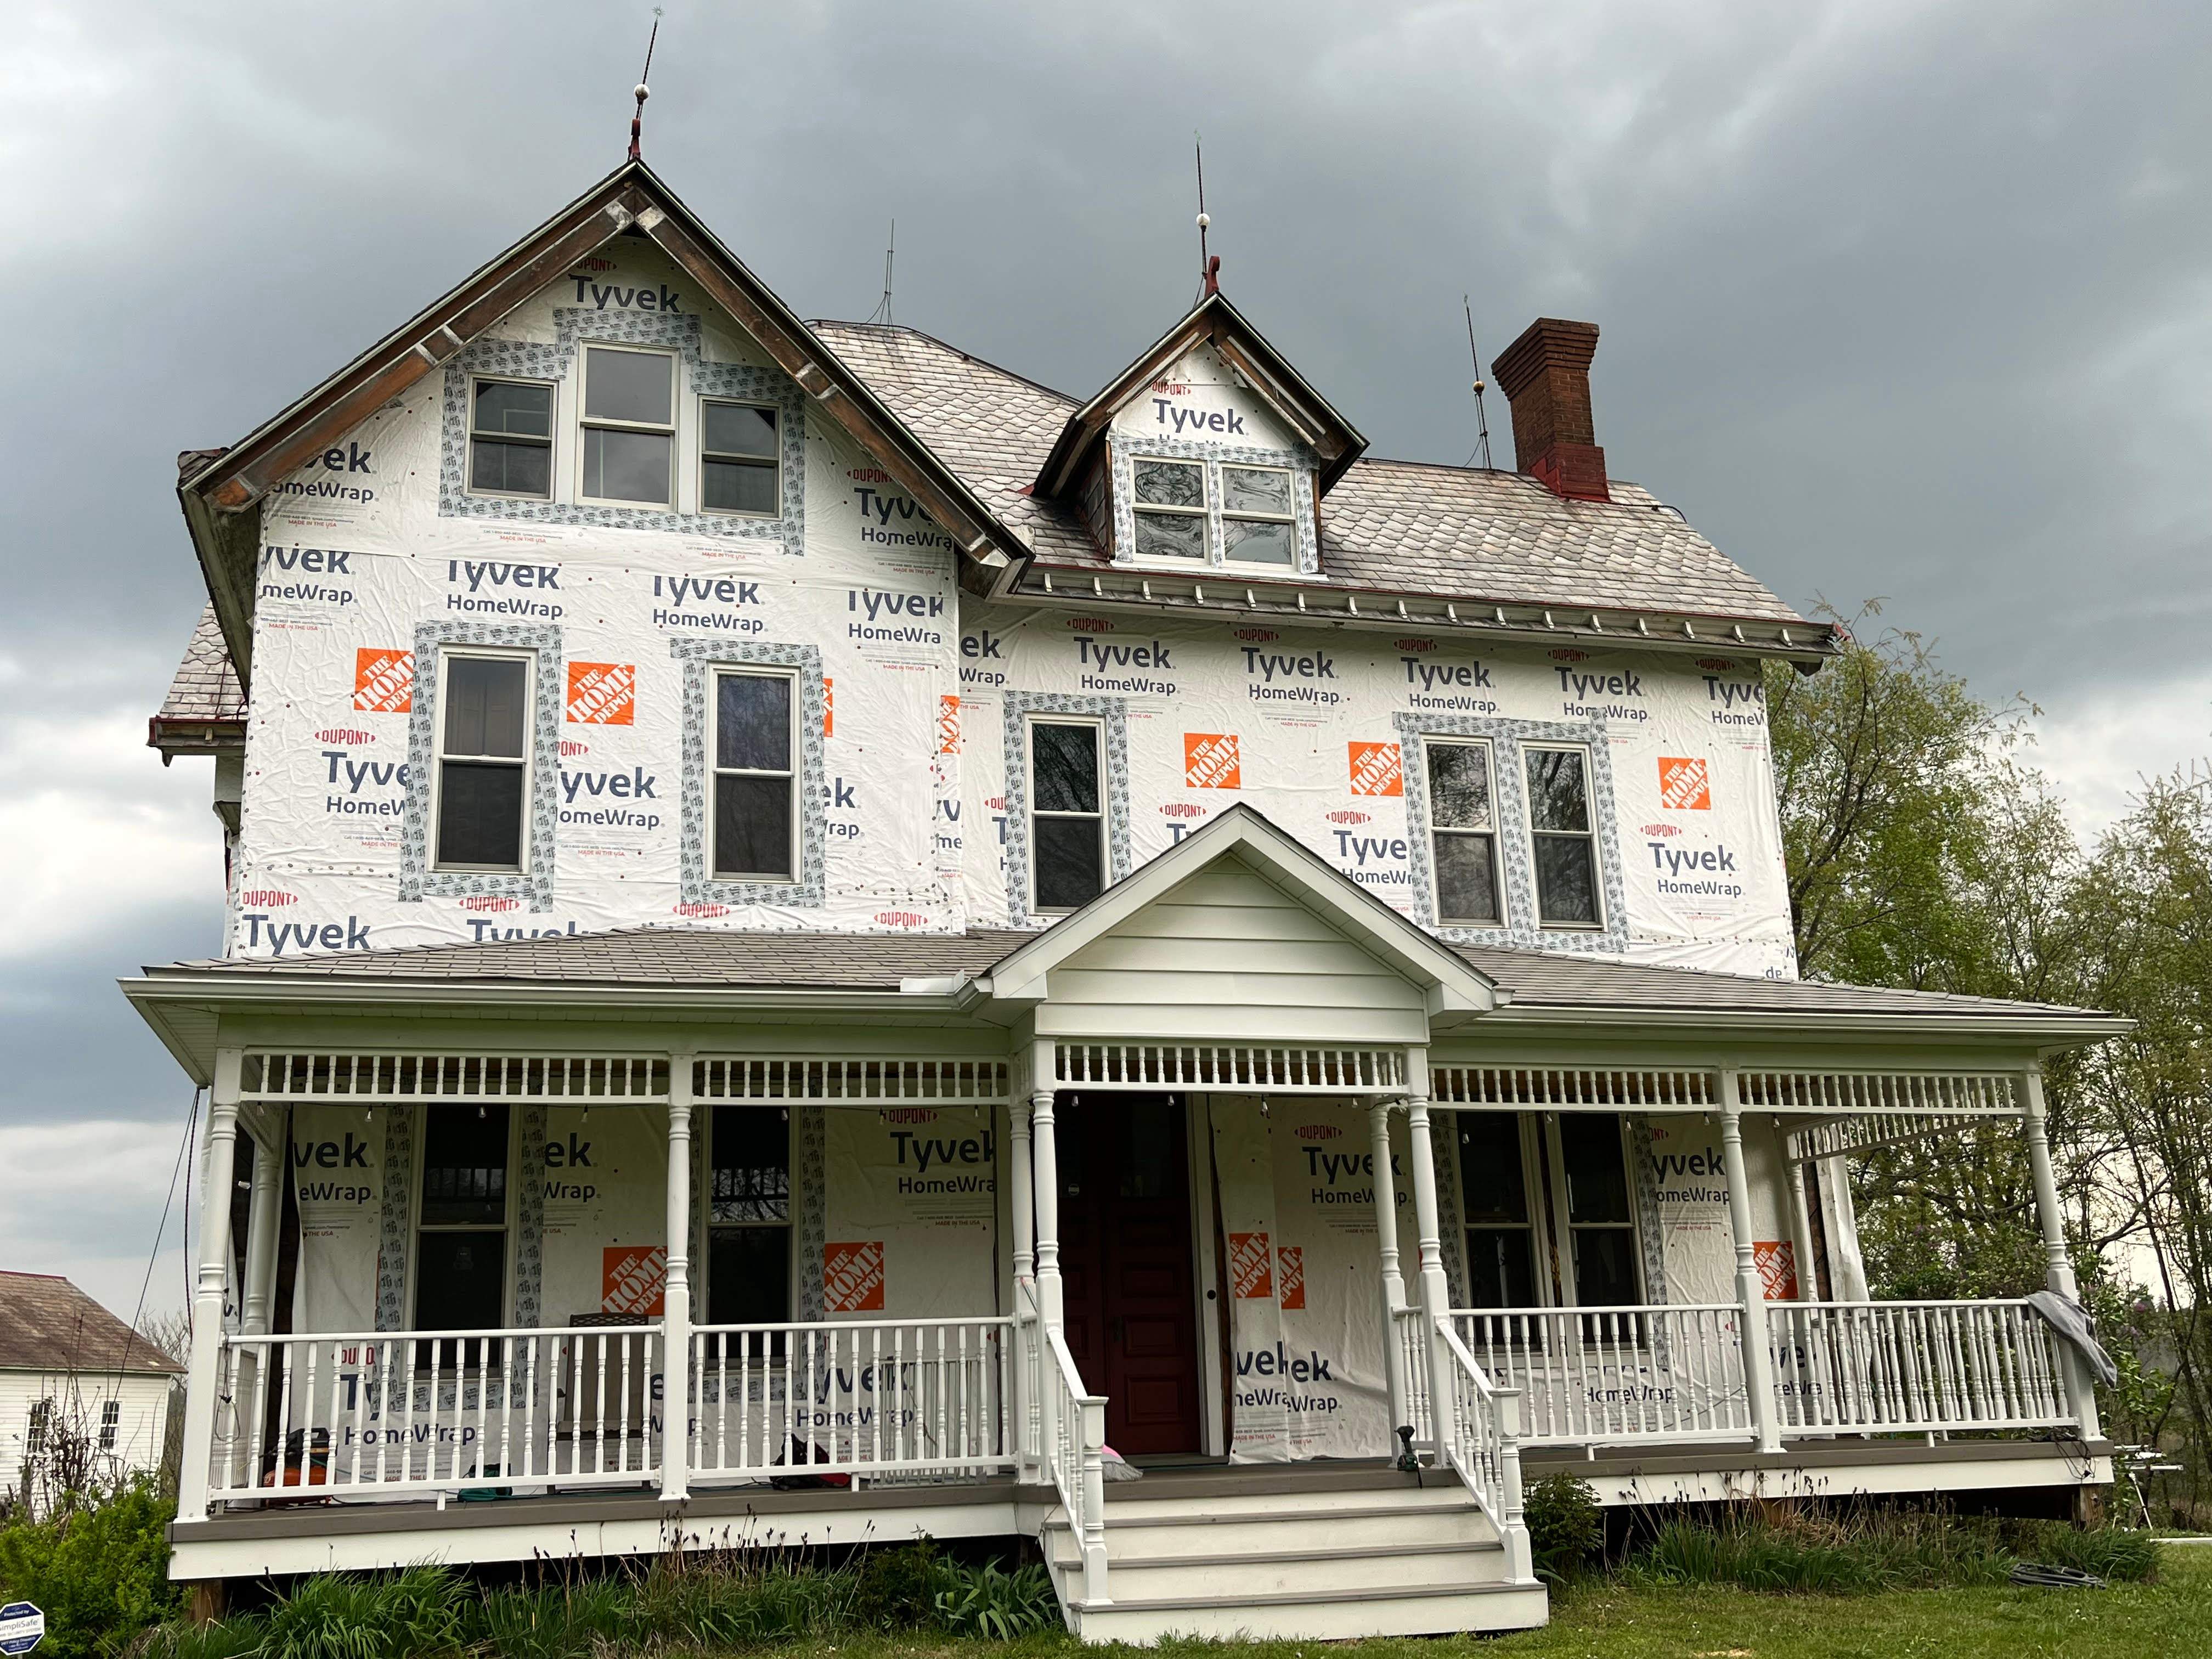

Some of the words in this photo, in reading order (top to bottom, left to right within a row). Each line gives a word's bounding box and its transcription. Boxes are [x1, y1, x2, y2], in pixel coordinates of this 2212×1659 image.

[578, 257, 612, 272] UPONT
[568, 274, 680, 313] Tyvek
[1152, 381, 1187, 395] DUPONT
[1153, 398, 1244, 435] Tyvek
[272, 481, 374, 504] omeWrap
[854, 488, 934, 525] Tyv
[862, 527, 952, 548] HomeWra
[261, 546, 350, 575] vek
[262, 584, 353, 605] meWrap
[447, 594, 563, 620] HomeWrap
[653, 609, 763, 634] HomeWrap
[849, 623, 940, 644] HomeWra
[1073, 618, 1109, 632] DUPONT
[1239, 629, 1274, 642] DUPONT
[1399, 639, 1434, 652] DUPONT
[1074, 636, 1171, 672] Tyvek
[1241, 647, 1335, 682] Tyvek
[1553, 649, 1585, 662] DUPONT
[1701, 658, 1730, 671] DUPONT
[363, 655, 393, 680] THE
[1401, 657, 1492, 691] Tyvek
[567, 664, 635, 723] HOME
[574, 669, 602, 693] THE
[1082, 674, 1176, 696] HomeWrap
[1555, 667, 1642, 700] Tyvek
[382, 683, 412, 712] DEP
[593, 688, 635, 725] DEPOT
[1249, 684, 1339, 706] HomeWrap
[1409, 693, 1496, 714] HomeWrap
[323, 729, 369, 745] DUPONT
[560, 741, 583, 756] ONT
[1190, 738, 1213, 761] THE
[1186, 733, 1239, 788] HOME
[1351, 743, 1401, 795] HOME
[1355, 747, 1374, 769] THE
[321, 751, 409, 793] Tyve
[557, 763, 656, 803] yvek
[1207, 754, 1239, 788] DEPOT
[1372, 763, 1402, 796] DEPOT
[1664, 763, 1683, 783] THE
[1662, 759, 1707, 809] HOME
[1680, 779, 1708, 810] DEPOT
[326, 797, 404, 815] Home
[1165, 804, 1201, 817] DUPONT
[1331, 812, 1366, 824] DUPONT
[1645, 824, 1677, 837] DUPONT
[1333, 830, 1407, 866] Tyve
[1647, 843, 1735, 877] Tyvek
[243, 891, 292, 907] DUPONT
[1658, 879, 1741, 898] HomeWrap
[467, 897, 514, 912] DUPONT
[680, 904, 725, 918] DUPONT
[881, 912, 922, 927] DUPONT
[242, 914, 371, 956] Tyvek
[889, 1108, 932, 1124] DUPONT
[1300, 1125, 1337, 1140] DUPONT
[294, 1132, 368, 1168] vek
[1652, 1147, 1725, 1184] yvek
[300, 1183, 371, 1204] eWrap
[544, 1181, 595, 1203] Wrap
[899, 1176, 995, 1194] HomeWra
[1657, 1187, 1729, 1205] omeWrap
[610, 1253, 639, 1283] THE
[824, 1249, 851, 1278] THE
[1232, 1233, 1269, 1283] OME
[1759, 1241, 1793, 1285] OME
[844, 1267, 884, 1311] DEPOT
[1236, 1256, 1271, 1299] DEPOT
[1280, 1270, 1304, 1304] EPOT
[1768, 1264, 1795, 1299] DEPOT
[629, 1273, 667, 1314] DEPO
